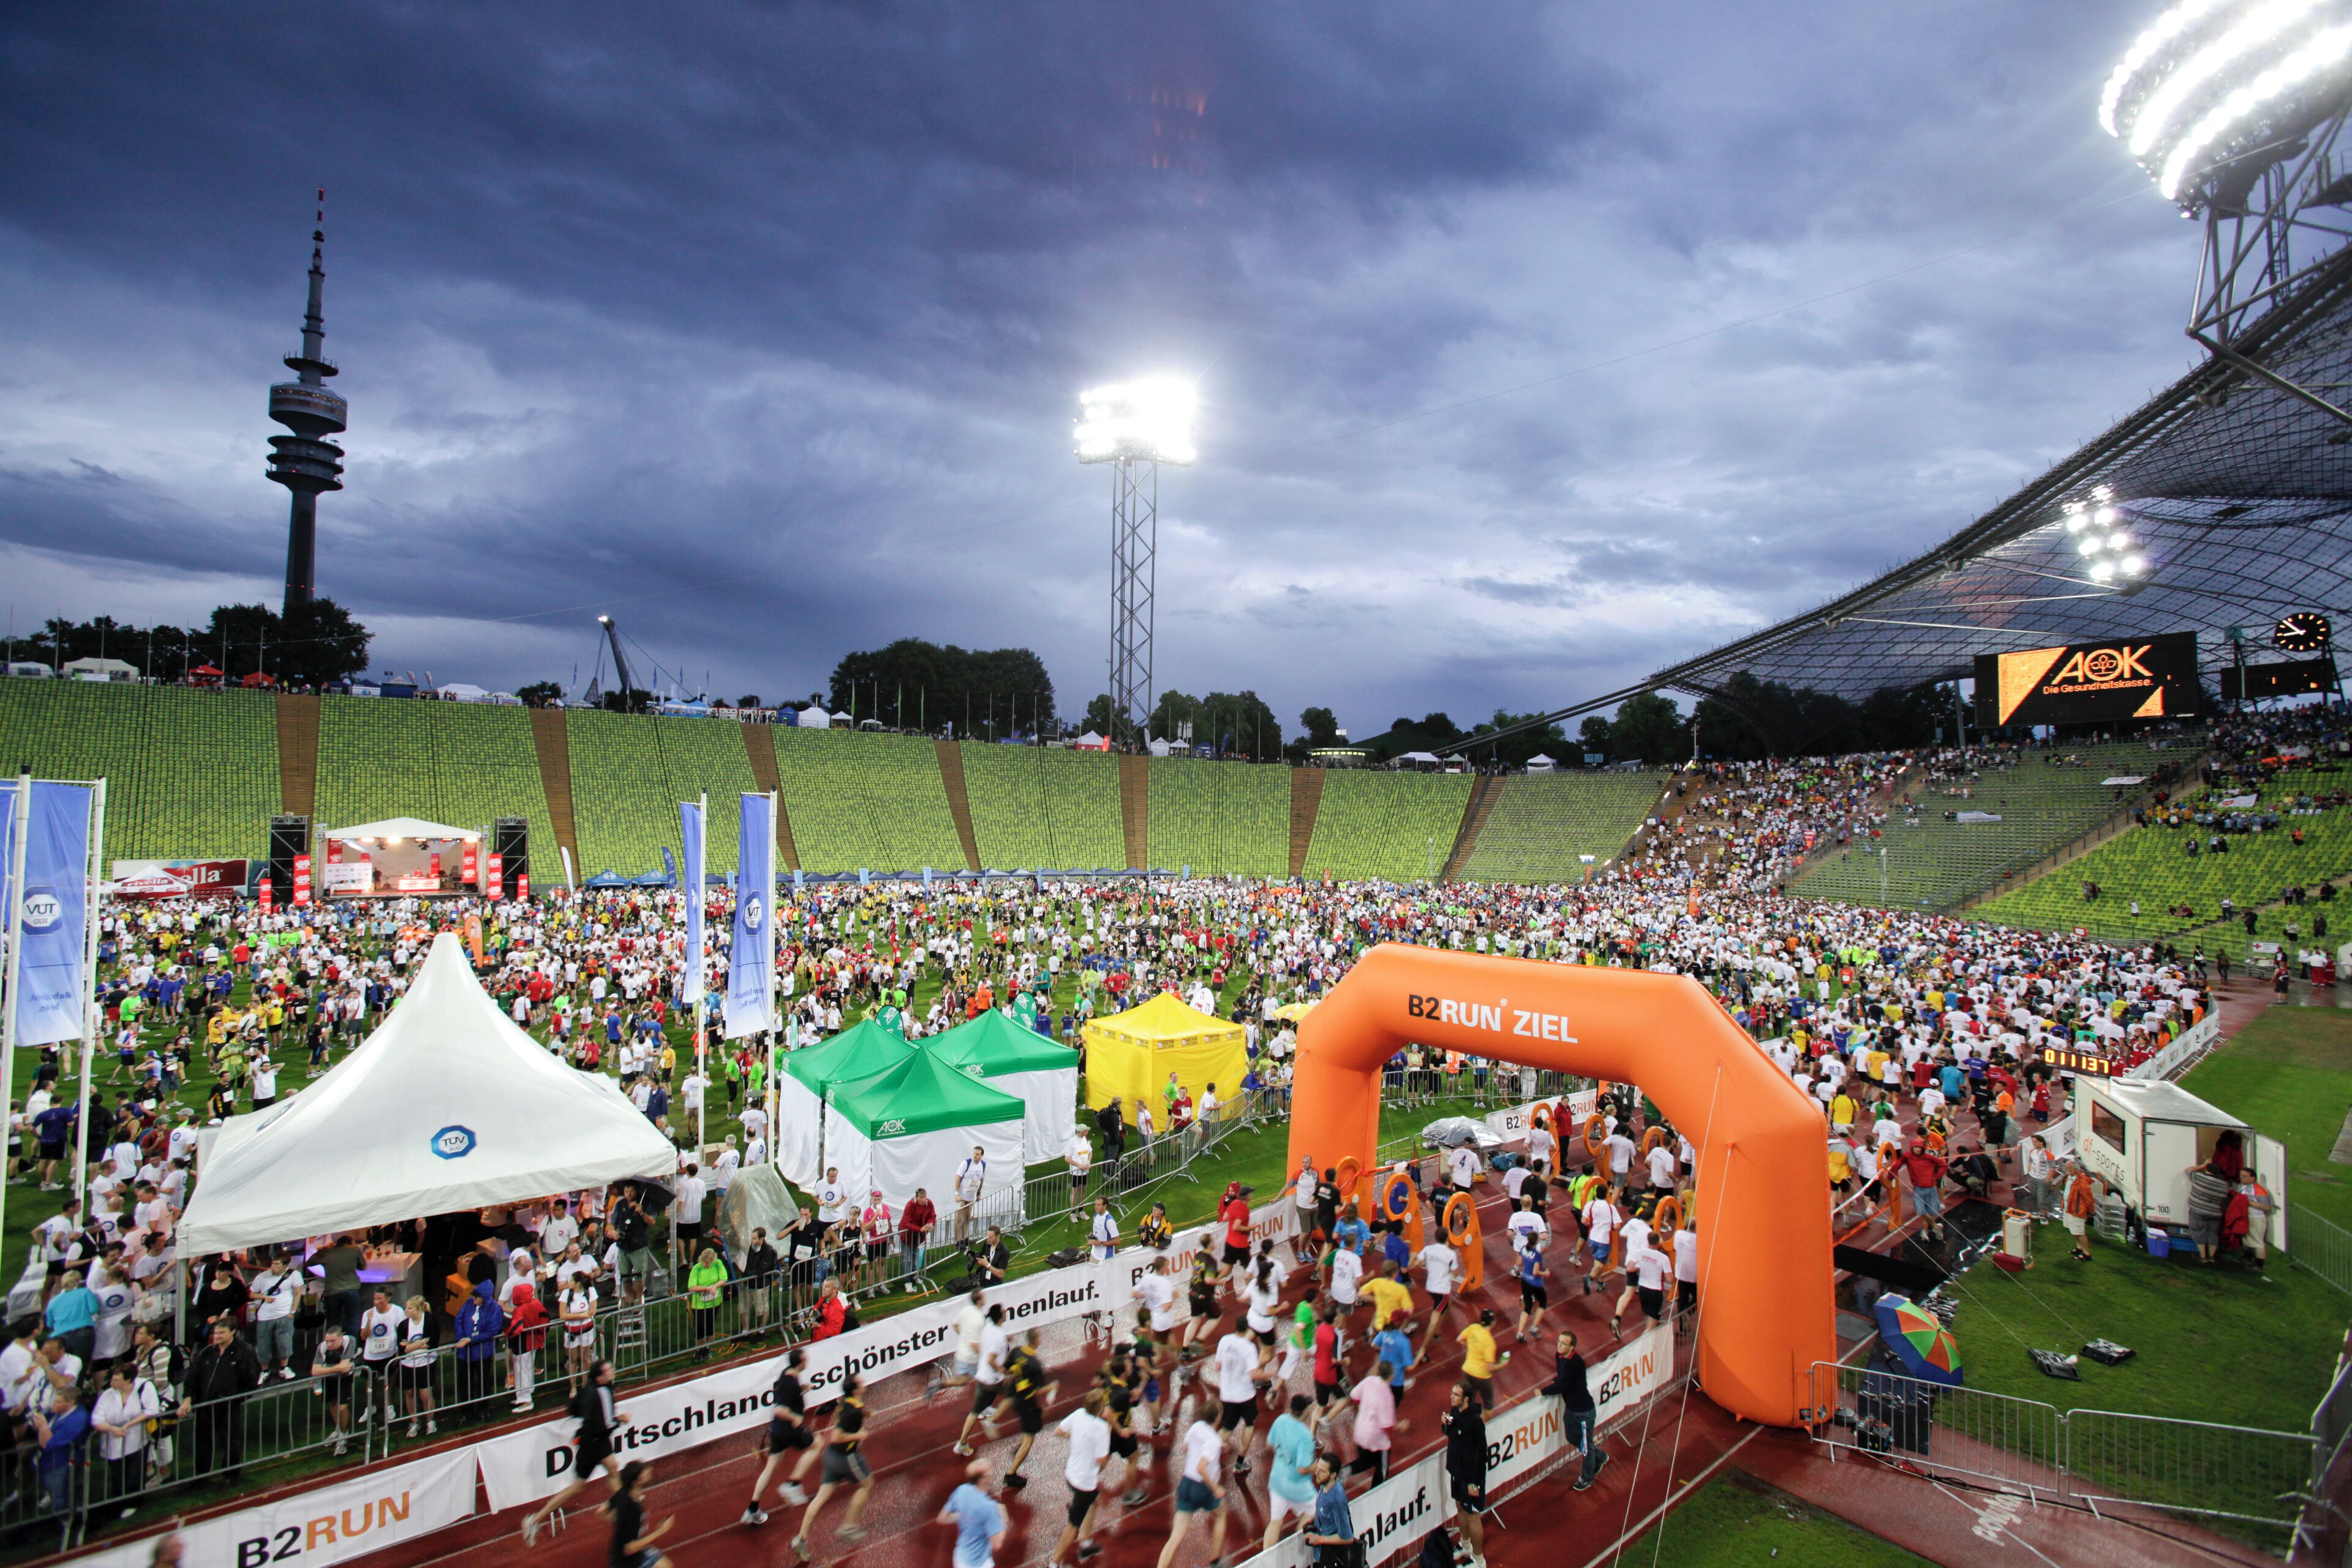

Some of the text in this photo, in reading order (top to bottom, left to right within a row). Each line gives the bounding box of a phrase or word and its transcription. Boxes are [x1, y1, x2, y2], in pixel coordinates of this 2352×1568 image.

[2051, 644, 2154, 685] AOK
[2043, 679, 2154, 695] Die Gesundheitskasse.
[127, 877, 169, 887] rivella
[178, 865, 221, 885] ella
[1513, 1009, 1578, 1044] ZIEL
[1571, 1095, 1597, 1116] 2RUN
[876, 1118, 905, 1134] AOK
[1460, 1155, 1467, 1167] 4
[1249, 1215, 1283, 1245] RUN
[810, 1325, 949, 1390] schönster
[1487, 1406, 1559, 1471] B2RUN
[1359, 1485, 1431, 1549] nlauf.
